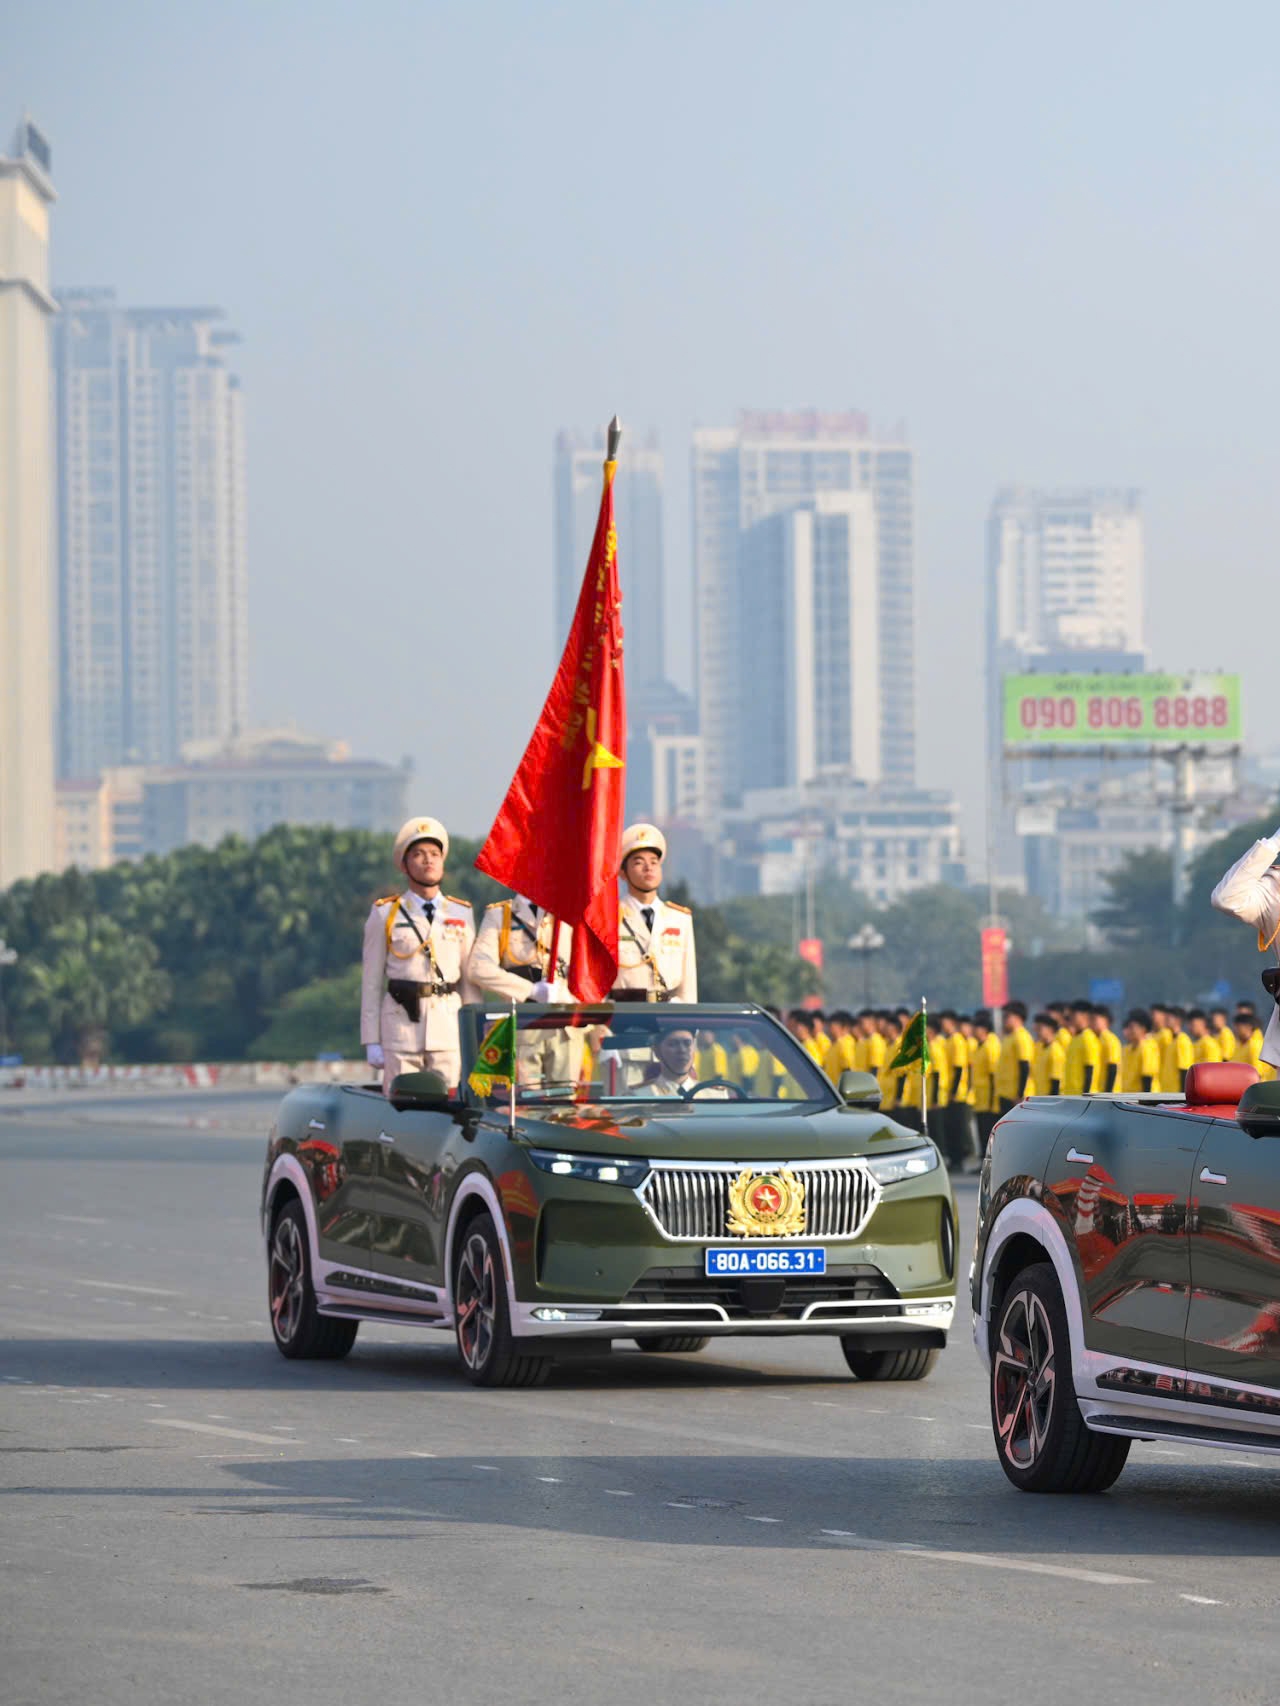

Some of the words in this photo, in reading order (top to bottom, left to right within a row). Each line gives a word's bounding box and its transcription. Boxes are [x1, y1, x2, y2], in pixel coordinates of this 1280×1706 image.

[1021, 697, 1076, 728] 090
[1088, 697, 1143, 728] 806
[1154, 697, 1228, 728] 8888
[716, 1252, 814, 1270] 80A-066.31
